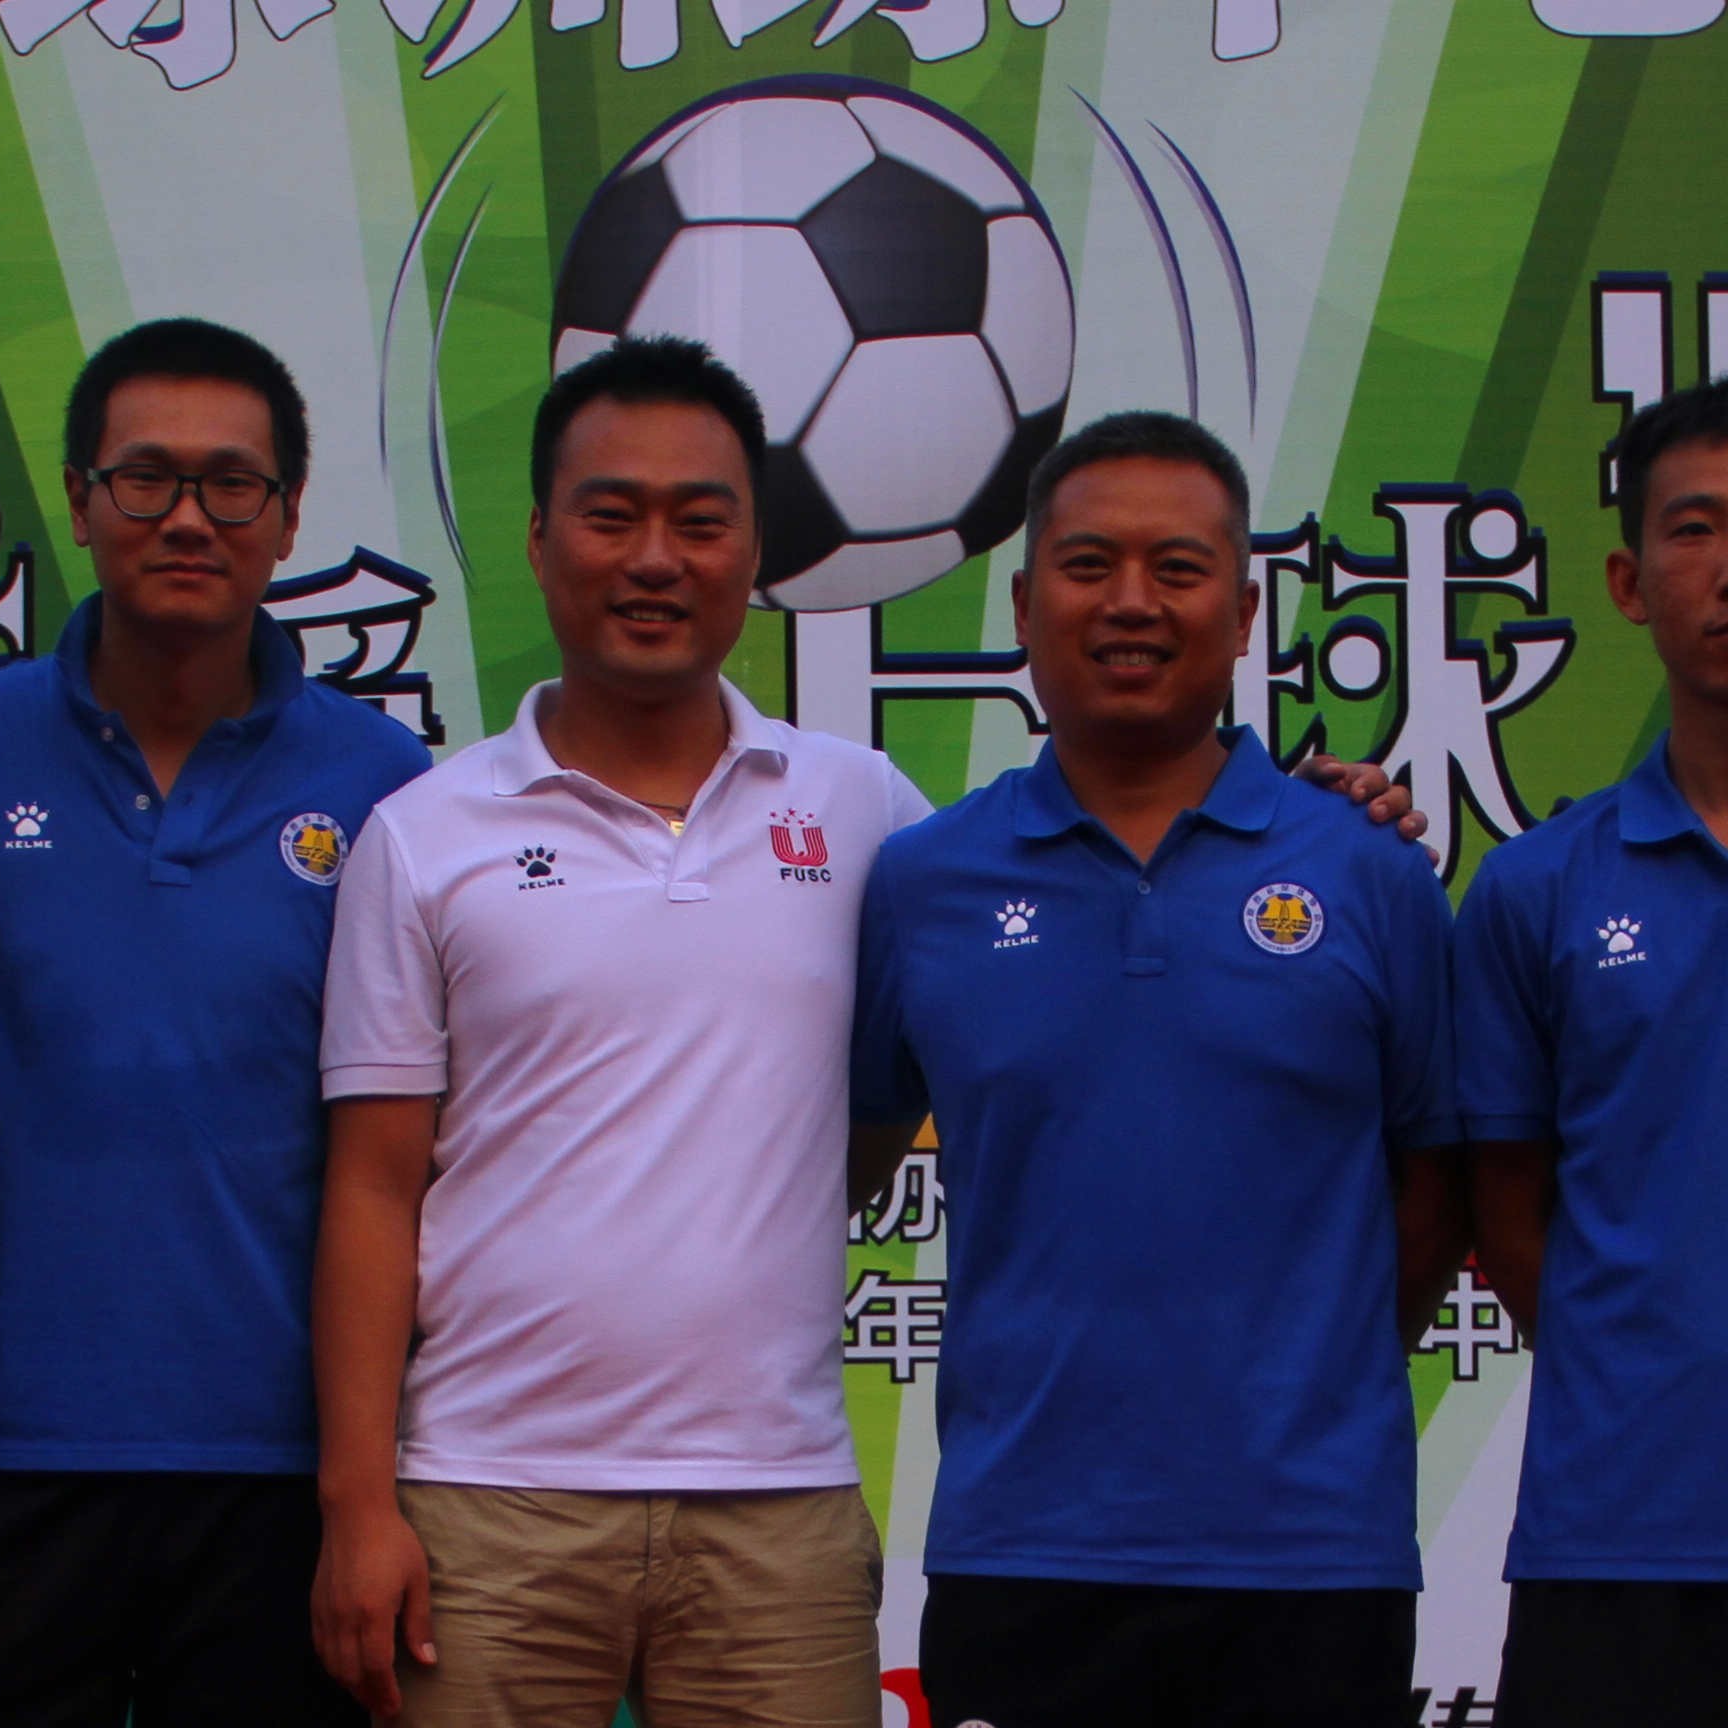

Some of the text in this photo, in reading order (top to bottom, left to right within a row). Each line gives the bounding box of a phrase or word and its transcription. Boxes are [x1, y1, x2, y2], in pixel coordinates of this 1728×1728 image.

[3, 839, 54, 849] KELME
[779, 866, 833, 883] FUSC
[518, 877, 567, 891] KELME
[993, 934, 1040, 949] KELME
[1597, 951, 1648, 969] KELME
